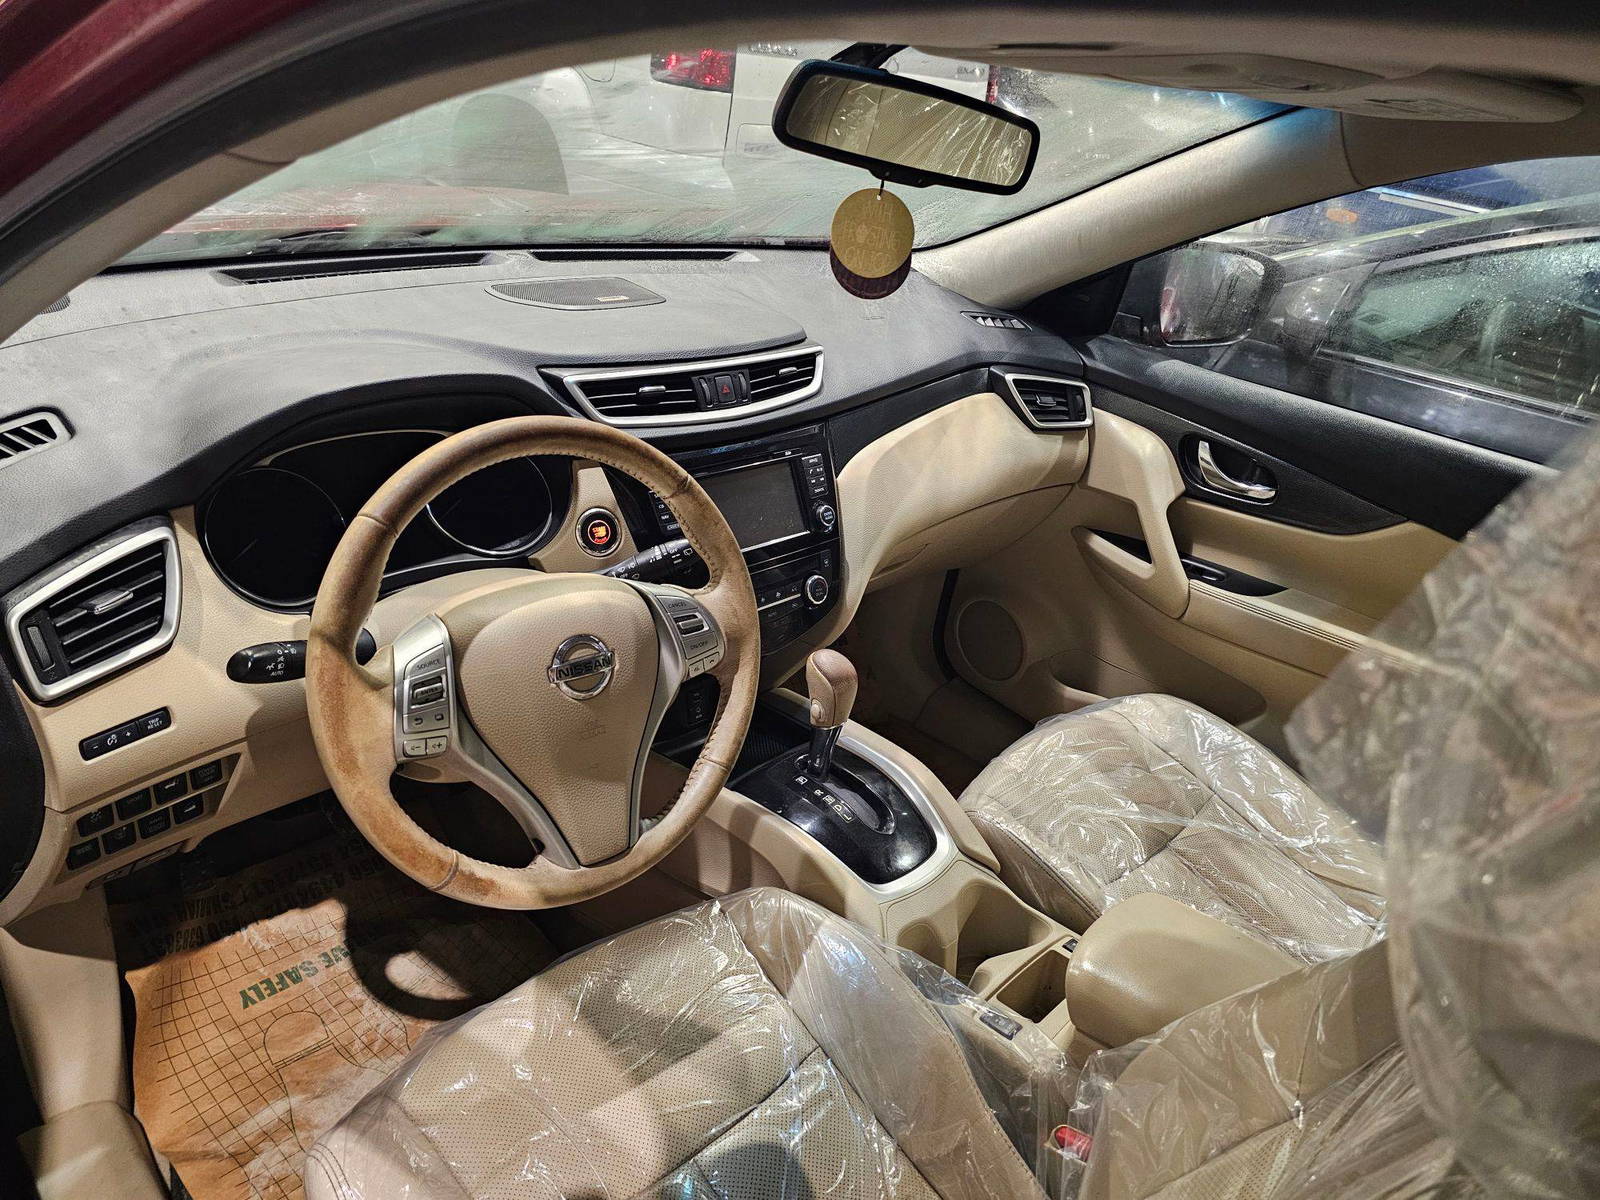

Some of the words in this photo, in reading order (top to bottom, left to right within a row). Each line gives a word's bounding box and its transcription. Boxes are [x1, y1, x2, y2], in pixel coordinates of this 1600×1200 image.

[668, 601, 687, 609] CANCEL
[416, 659, 441, 671] SOURCE
[558, 653, 613, 679] NISSAN
[834, 804, 842, 812] D
[843, 813, 852, 821] L
[239, 960, 320, 1010] SAFELY
